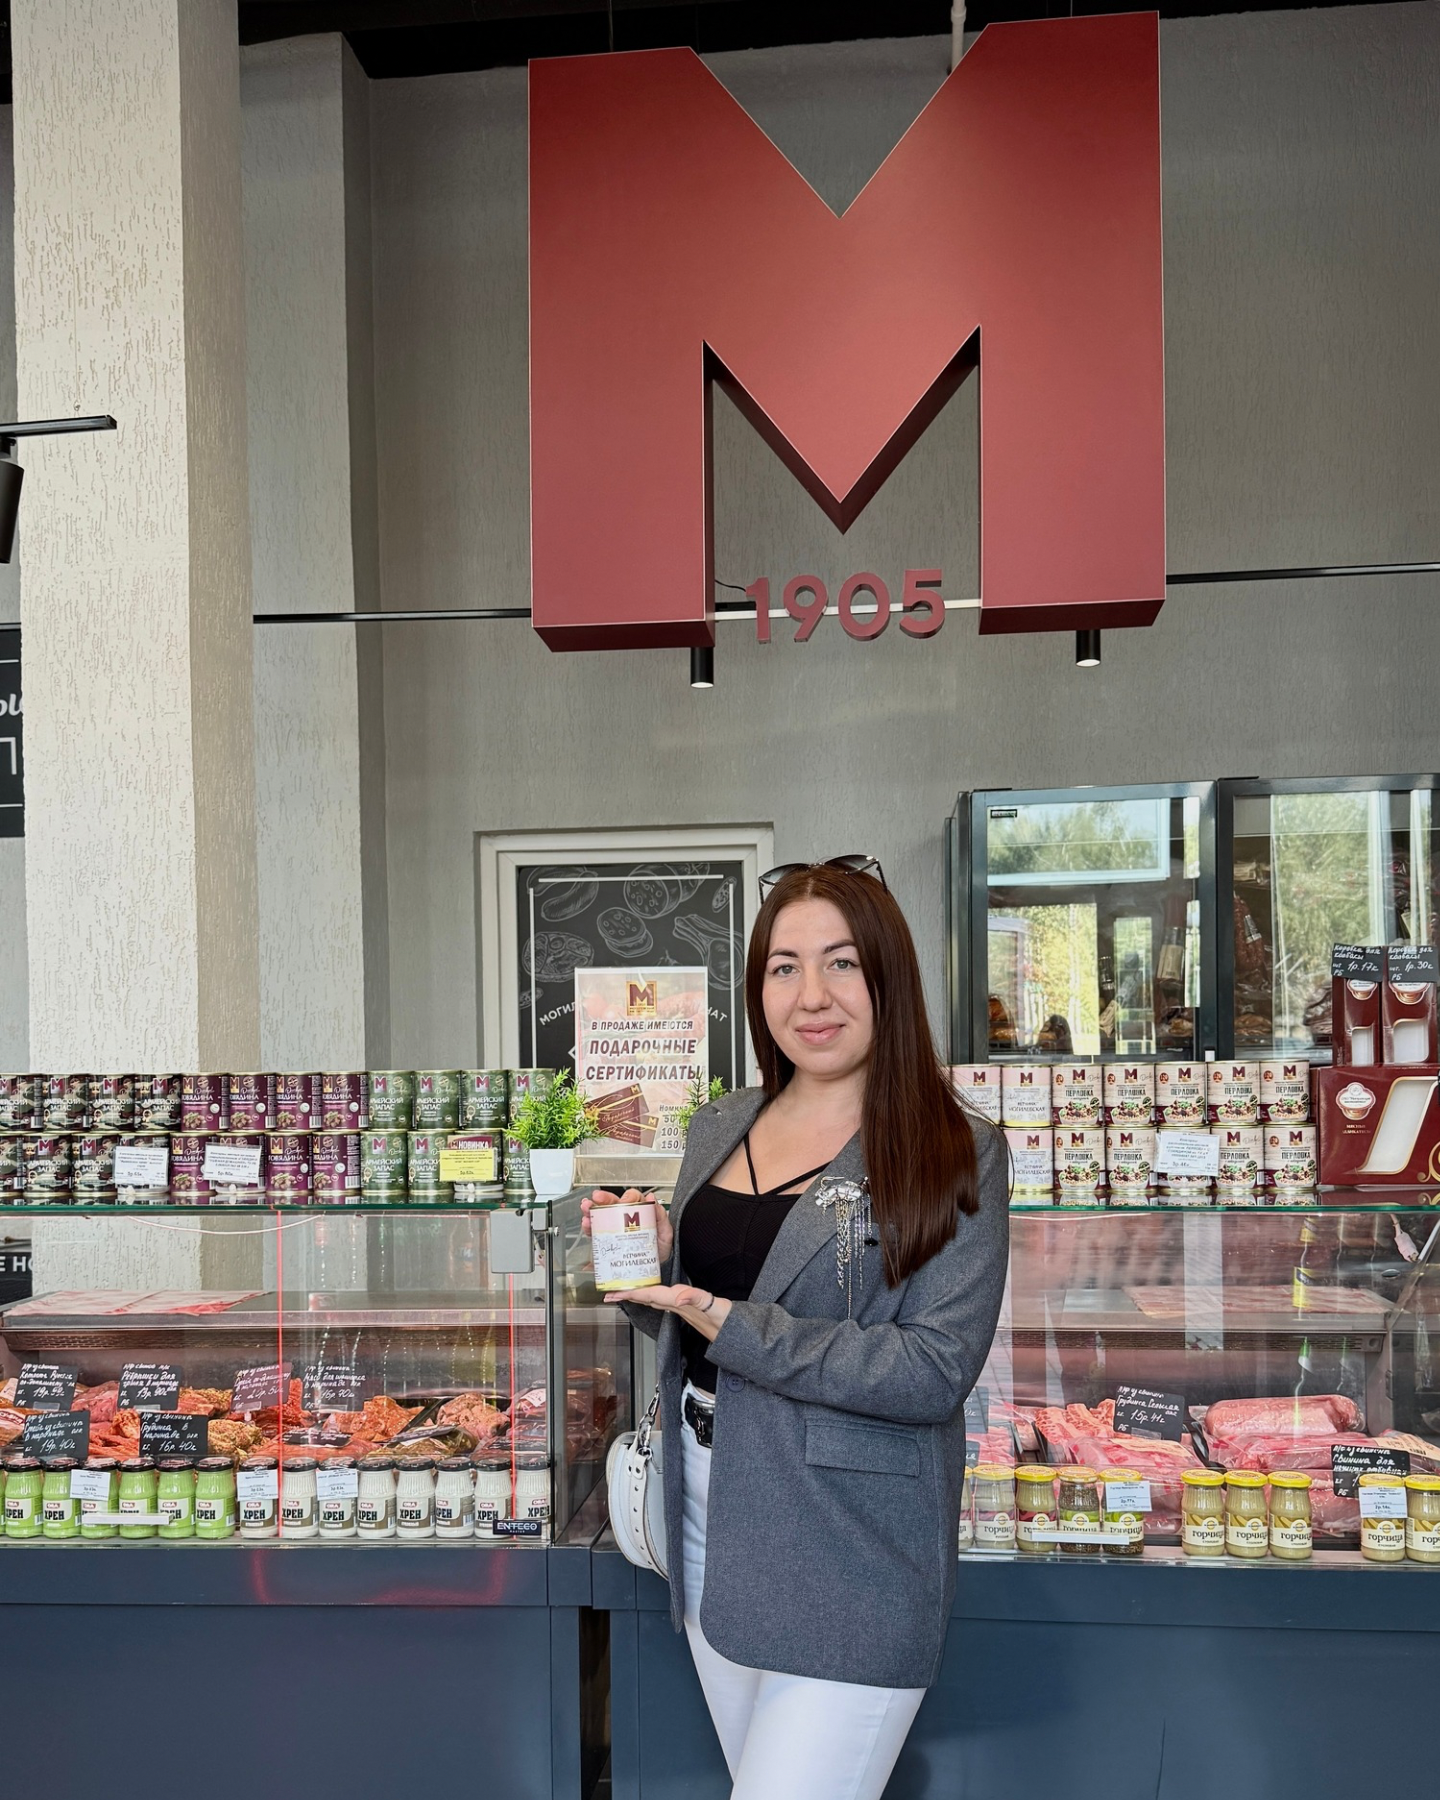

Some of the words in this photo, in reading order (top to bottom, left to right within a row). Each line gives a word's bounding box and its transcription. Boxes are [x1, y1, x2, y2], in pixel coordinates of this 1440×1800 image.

[529, 11, 1166, 651] М
[745, 568, 946, 644] 1905
[629, 984, 655, 1006] М
[591, 1021, 598, 1030] В
[601, 1021, 644, 1031] ПРОДАЖЕ
[647, 1021, 693, 1030] ИМЕЮТСЯ
[590, 1039, 697, 1056] ПОДАРОЧНЫЕ
[1073, 1068, 1086, 1081] М
[1124, 1068, 1138, 1080] М
[1178, 1067, 1192, 1079] М
[1232, 1066, 1246, 1078] М
[1283, 1064, 1297, 1077] М
[974, 1071, 986, 1084] М
[1020, 1072, 1033, 1084] М
[50, 1078, 65, 1090] М
[103, 1078, 117, 1090] М
[153, 1078, 168, 1090] М
[663, 1114, 676, 1123] 50
[661, 1127, 678, 1136] 100
[1226, 1131, 1241, 1143] М
[1289, 1130, 1303, 1142] М
[1026, 1135, 1040, 1147] М
[1071, 1132, 1085, 1144] М
[1120, 1132, 1134, 1144] М
[38, 1139, 53, 1152] М
[82, 1139, 97, 1152] М
[458, 1140, 489, 1150] НОВИНКА
[661, 1140, 679, 1149] 150
[624, 1211, 641, 1228] М
[1337, 1488, 1349, 1496] РБ
[44, 1509, 65, 1521] ХРЕН
[243, 1508, 266, 1520] ХРЕН
[282, 1507, 304, 1519] ХРЕН
[322, 1510, 345, 1521] ХРЕН
[399, 1508, 422, 1520] ХРЕН
[477, 1509, 499, 1521] ХРЕН
[527, 1505, 550, 1518] ХРЕН
[496, 1522, 538, 1531] ENTECO
